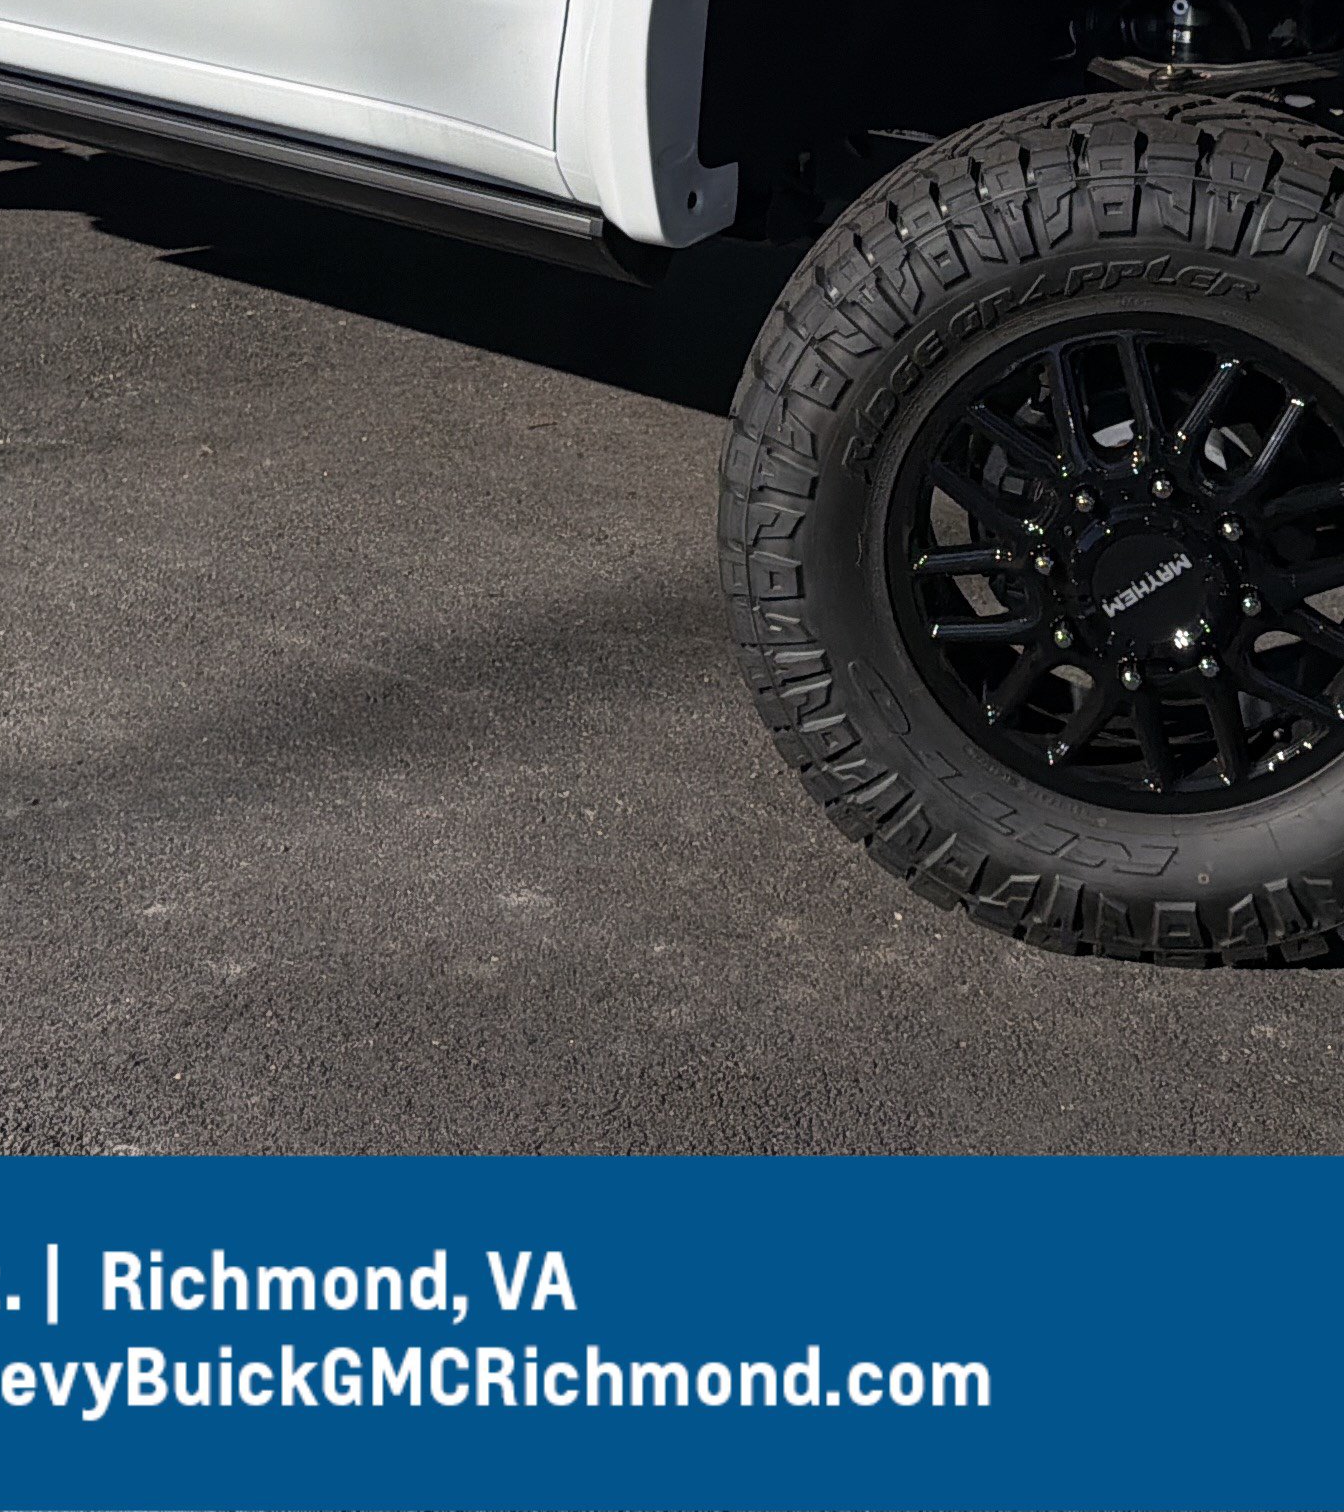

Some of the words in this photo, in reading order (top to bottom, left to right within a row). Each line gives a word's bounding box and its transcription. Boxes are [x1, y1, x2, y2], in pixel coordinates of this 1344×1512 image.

[841, 329, 948, 486] RIDGE
[948, 253, 1261, 342] GRAPPLER
[1101, 552, 1194, 619] MAYHEM
[847, 660, 1179, 878] NITTO
